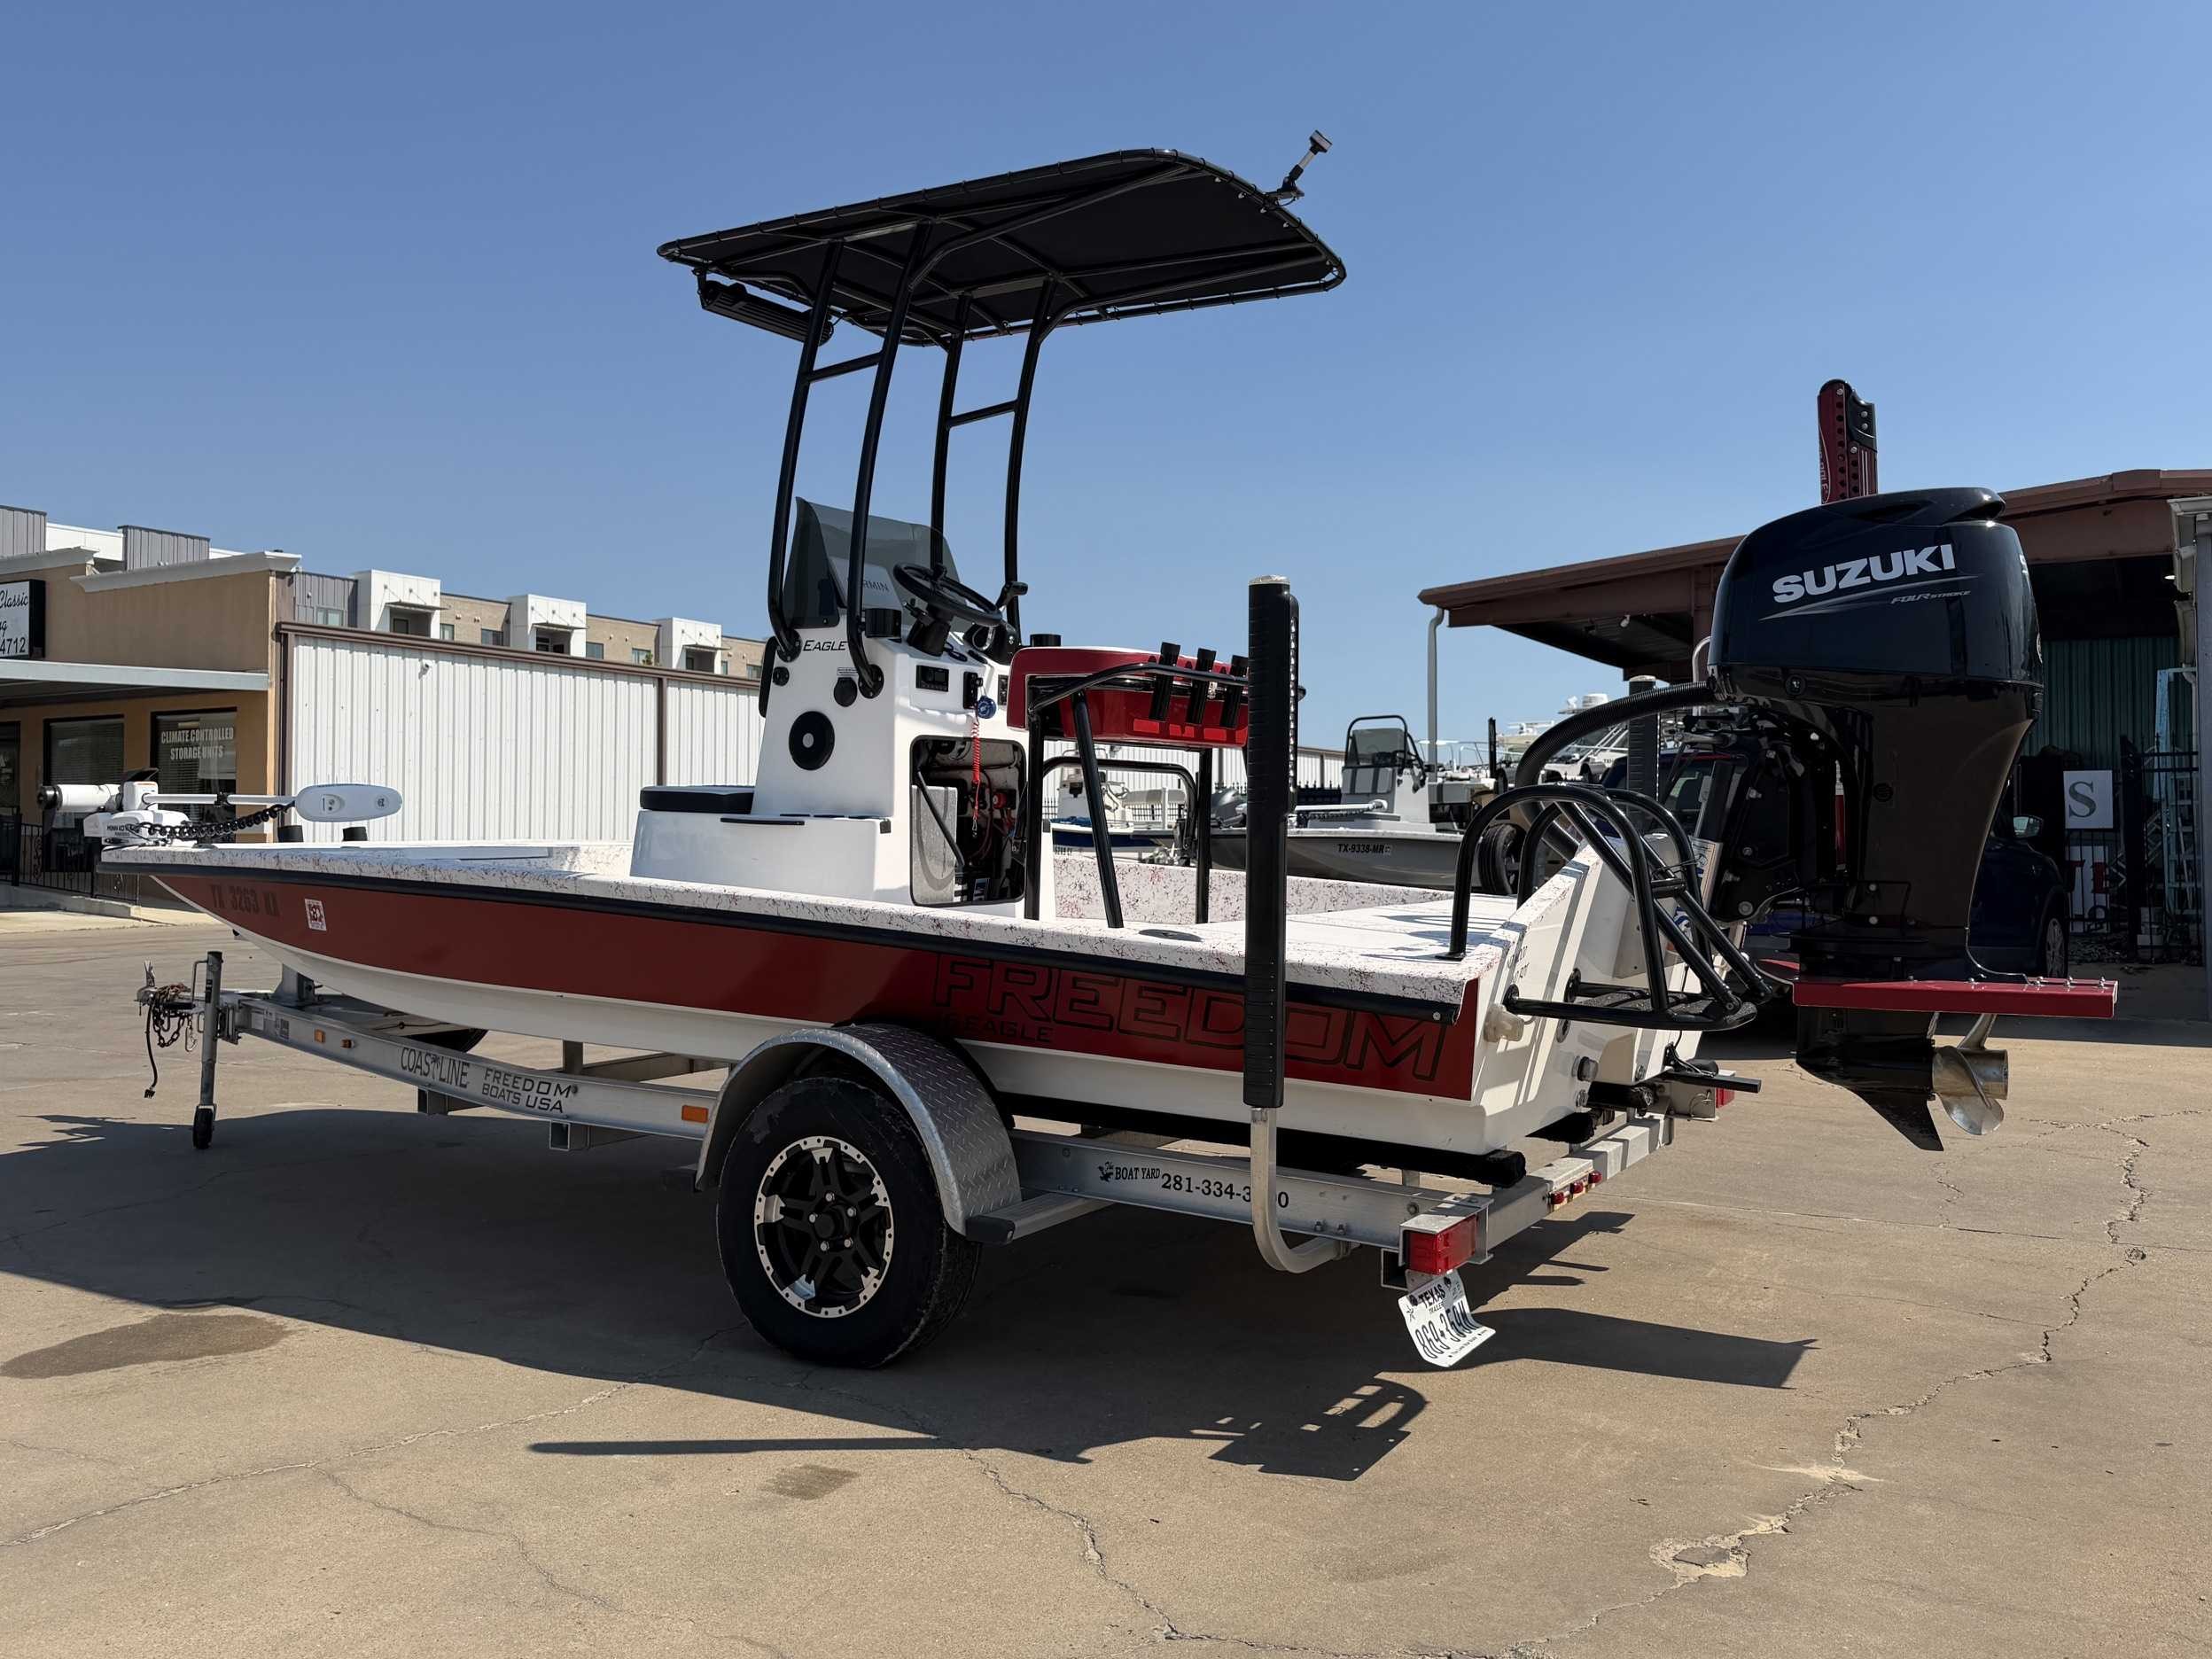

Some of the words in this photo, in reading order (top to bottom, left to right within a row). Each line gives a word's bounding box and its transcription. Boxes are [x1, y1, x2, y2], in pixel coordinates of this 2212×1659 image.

[1772, 543, 1956, 604] SUZUKI
[803, 640, 848, 651] EAGLE
[161, 729, 190, 744] CLIMATE
[190, 727, 234, 743] CONTROLLED
[170, 746, 200, 760] STORAGE
[201, 744, 224, 759] UNITS
[2068, 781, 2097, 818] S
[484, 1068, 572, 1098] FREEDOM
[481, 1083, 521, 1105] BOATS
[526, 1095, 564, 1114] USA
[1115, 1167, 1140, 1180] BOAT
[1141, 1167, 1160, 1180] YARD
[1161, 1172, 1289, 1209] 281-334-30
[1419, 1284, 1446, 1309] TEXAS
